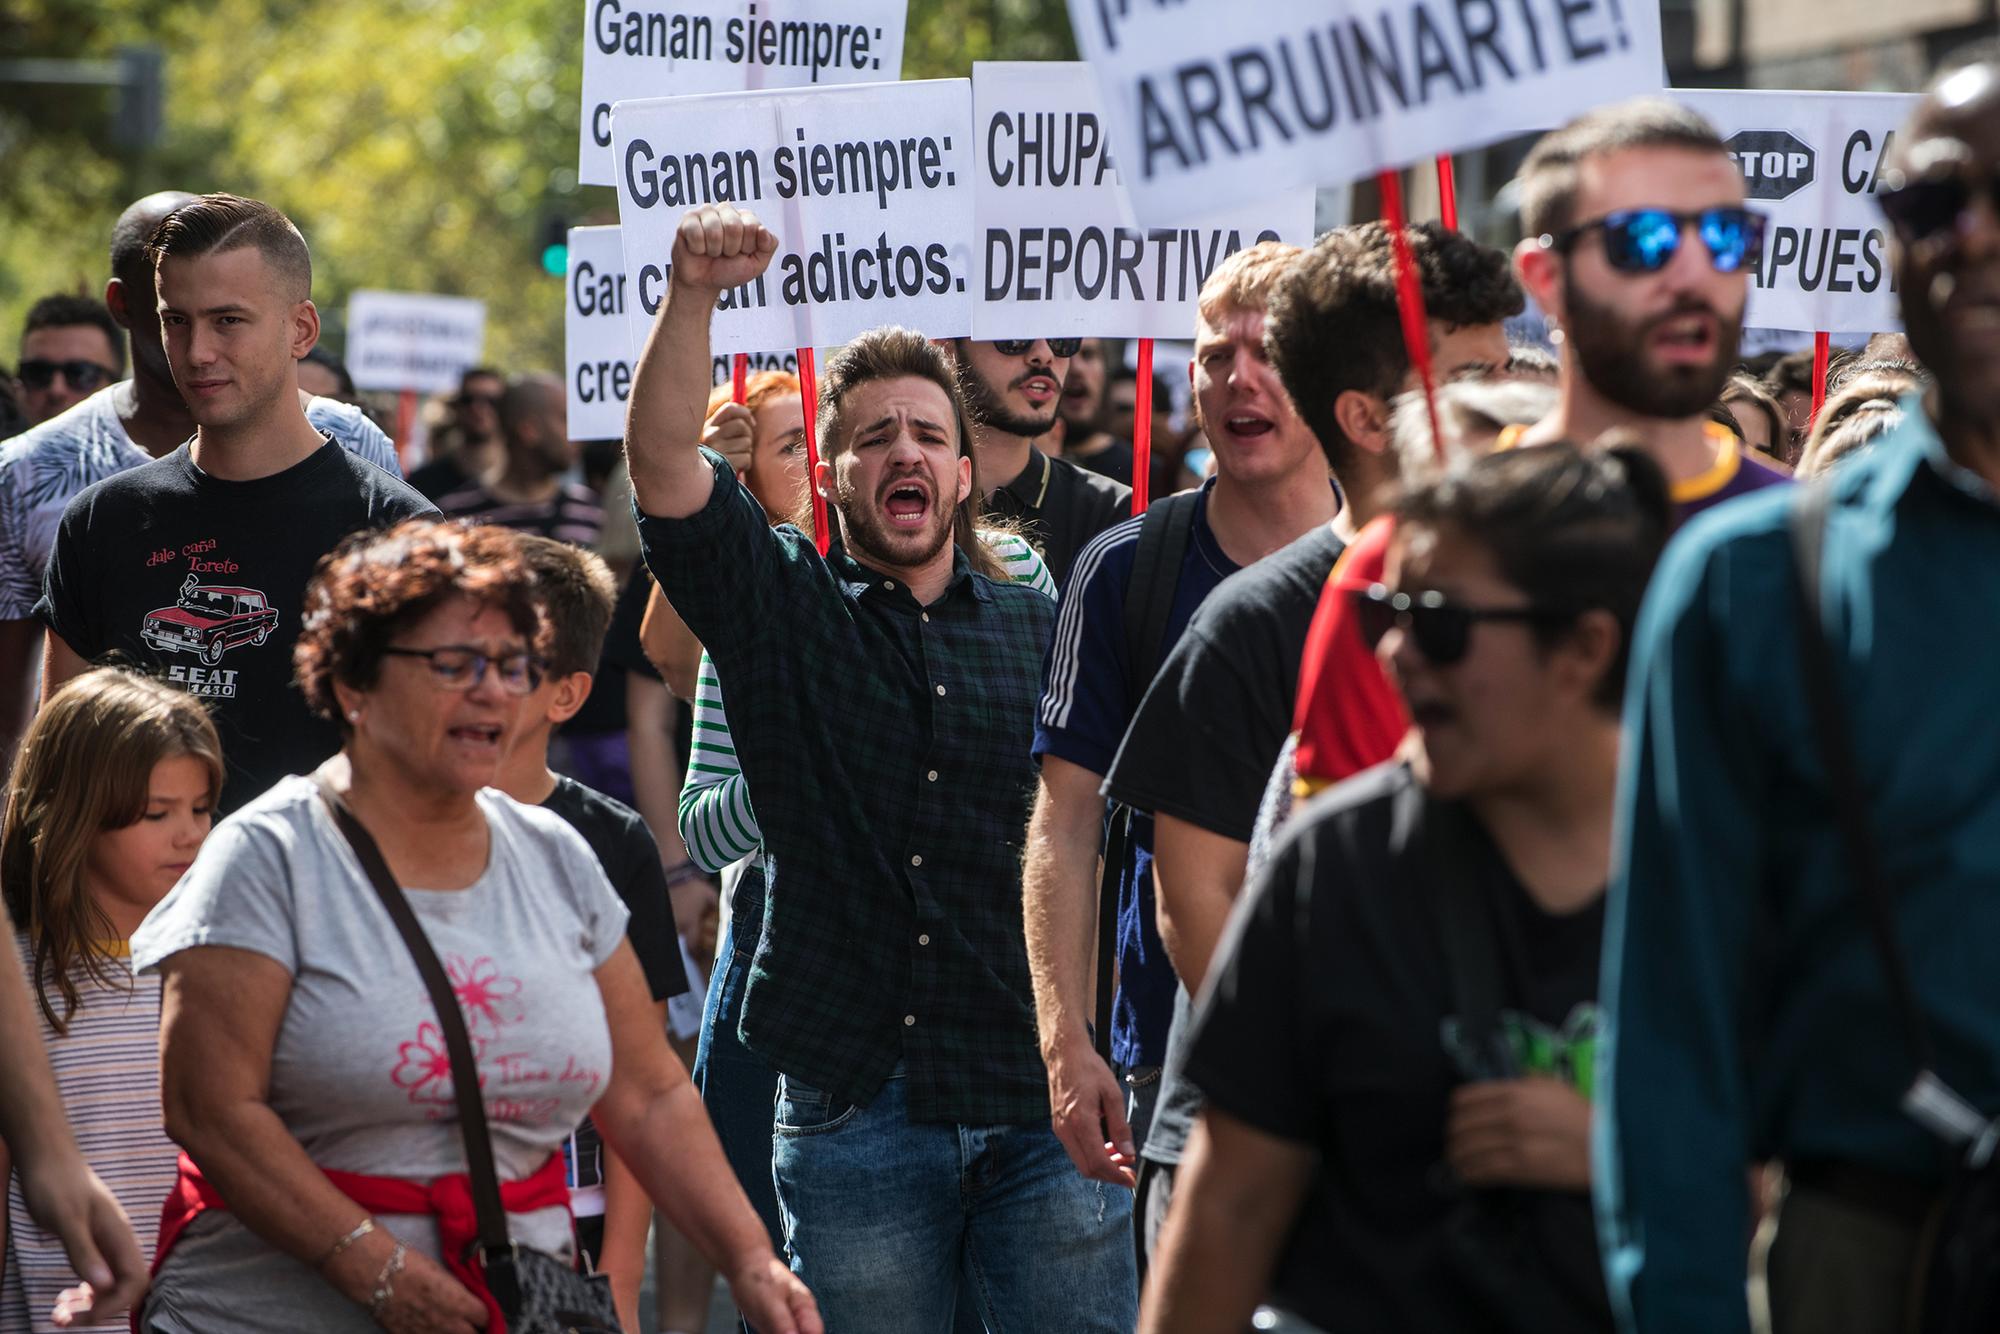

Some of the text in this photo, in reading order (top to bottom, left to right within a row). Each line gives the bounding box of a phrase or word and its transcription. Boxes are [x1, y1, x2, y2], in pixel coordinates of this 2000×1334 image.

[595, 0, 882, 82] Ganan siempre:
[625, 128, 956, 209] Ganan siempre:
[781, 231, 966, 306] adictos.
[984, 226, 1282, 302] DEPORTIV
[146, 538, 217, 567] dale caña
[187, 556, 239, 574] Torete
[168, 665, 239, 686] SEAT
[191, 684, 233, 696] 1430
